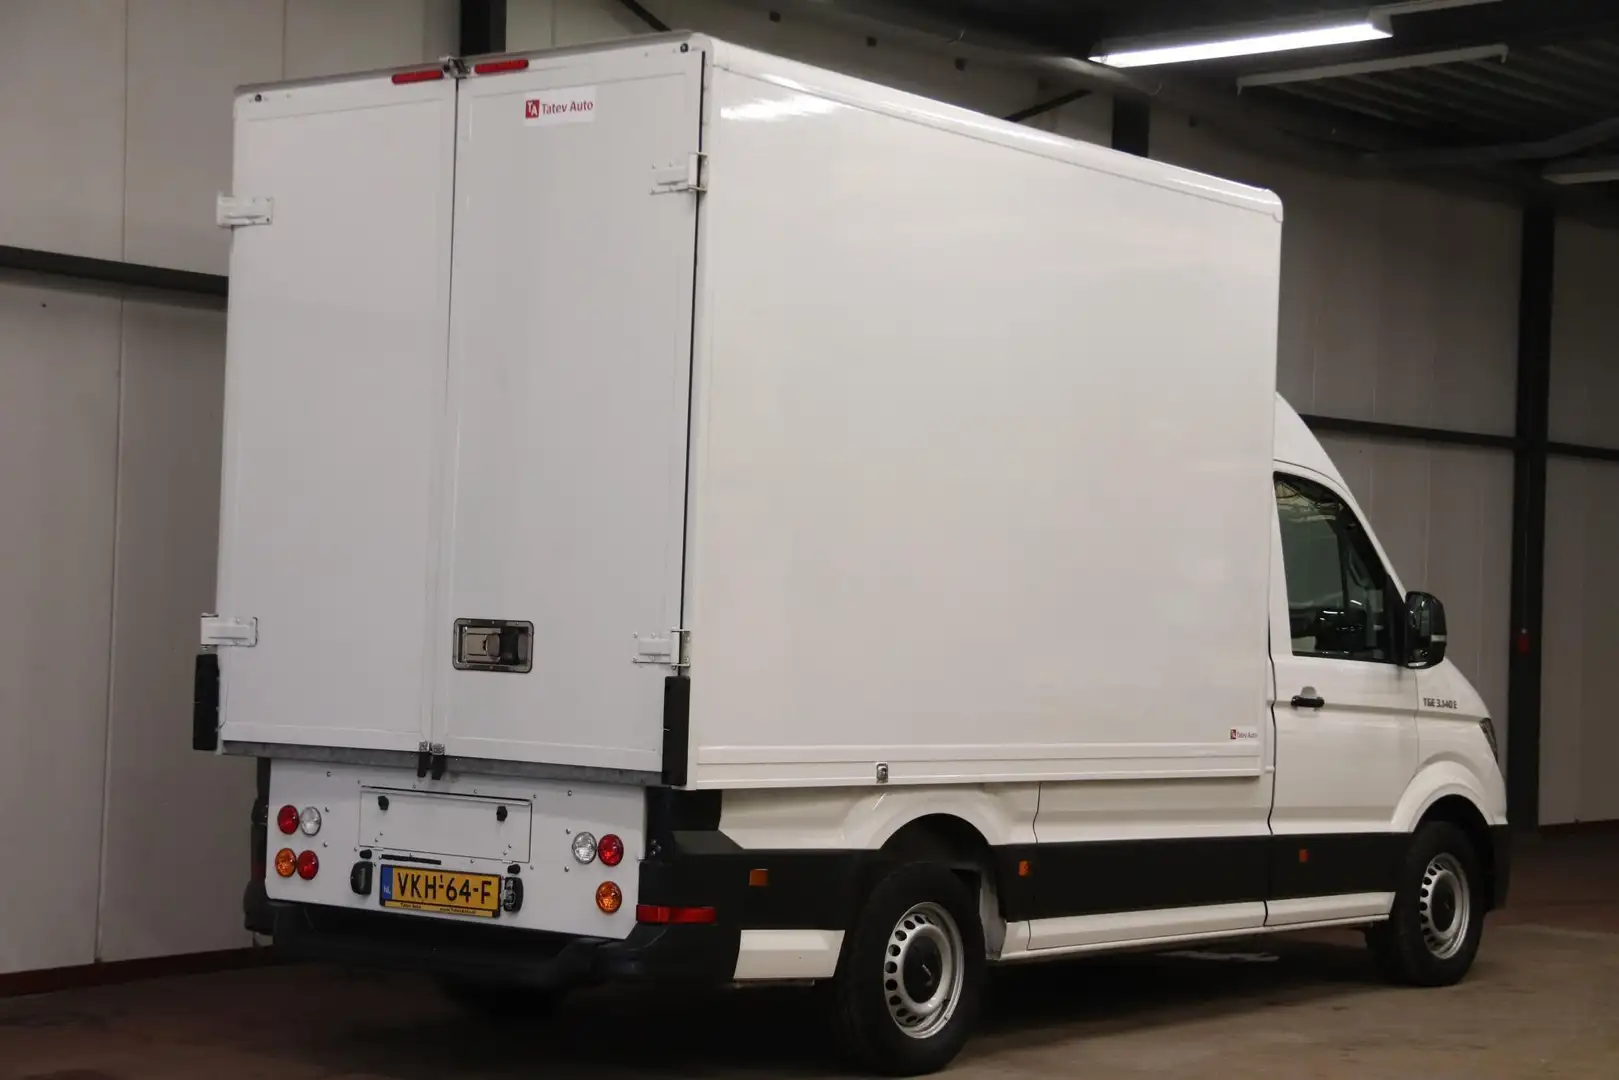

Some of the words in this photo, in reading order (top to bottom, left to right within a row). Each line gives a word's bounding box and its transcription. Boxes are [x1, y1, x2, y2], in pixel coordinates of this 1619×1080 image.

[542, 103, 568, 115] Tatev
[569, 99, 594, 112] Auto
[383, 885, 392, 894] NL
[397, 872, 492, 905] VKH-64-F
